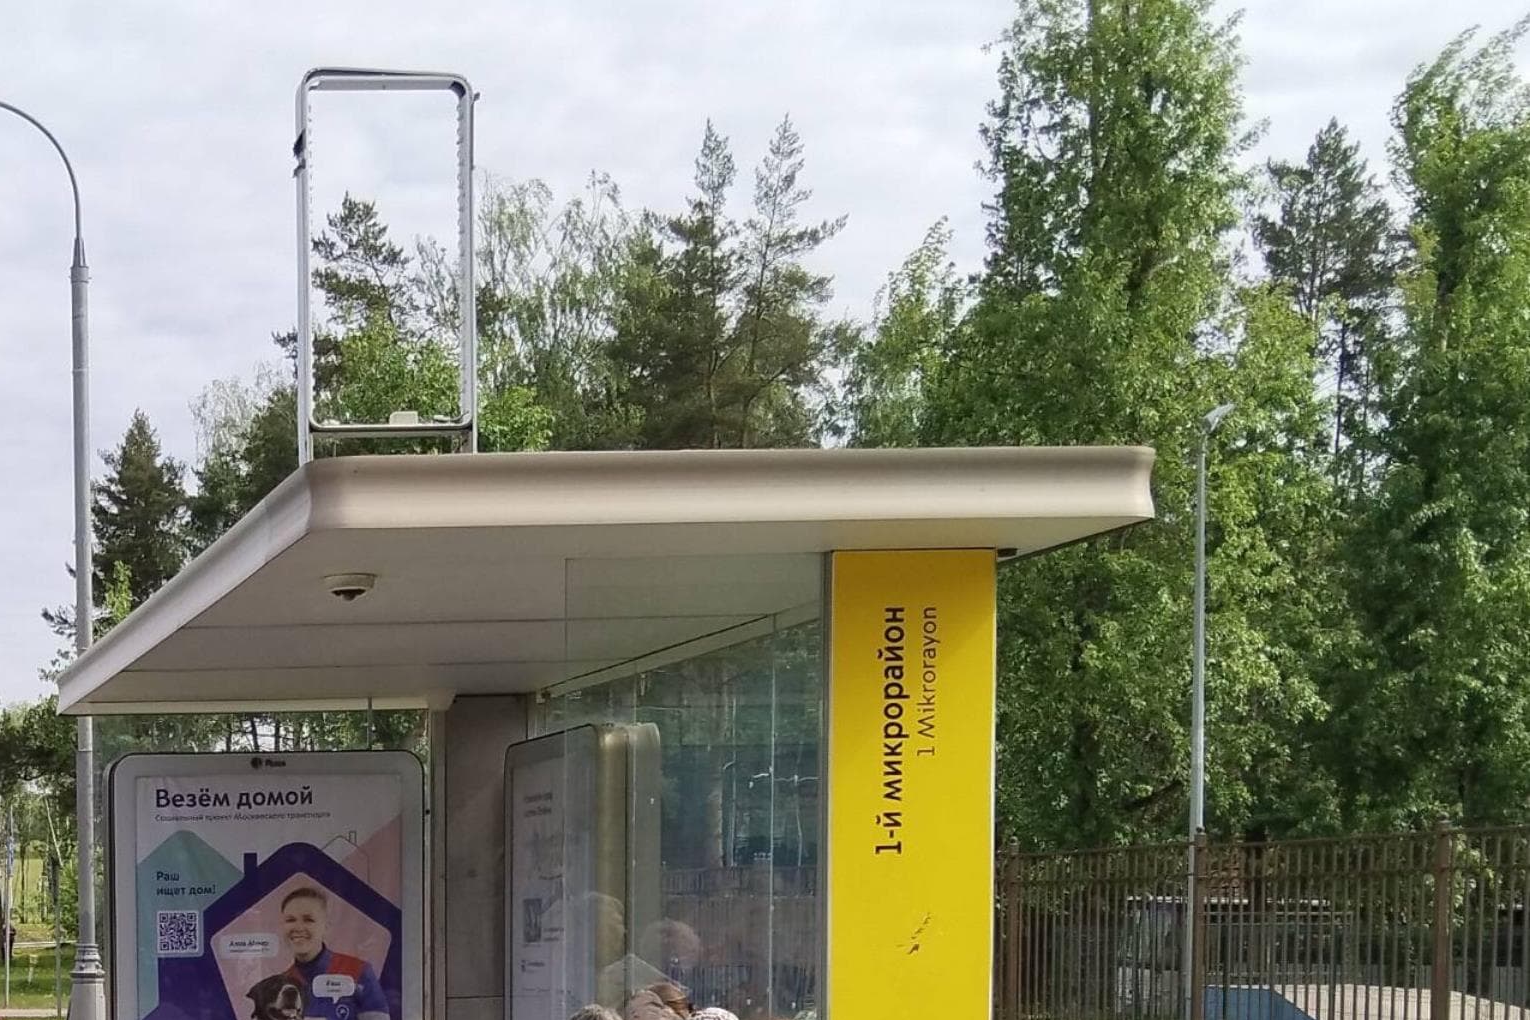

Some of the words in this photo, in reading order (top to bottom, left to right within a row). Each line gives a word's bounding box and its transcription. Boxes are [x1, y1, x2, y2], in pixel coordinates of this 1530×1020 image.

[916, 606, 941, 739] Mikrorayon
[877, 606, 910, 801] микрорайон
[916, 746, 935, 757] 1
[155, 788, 230, 809] Везём
[236, 786, 313, 809] домой
[875, 811, 903, 855] 1-й
[156, 870, 180, 882] Раш
